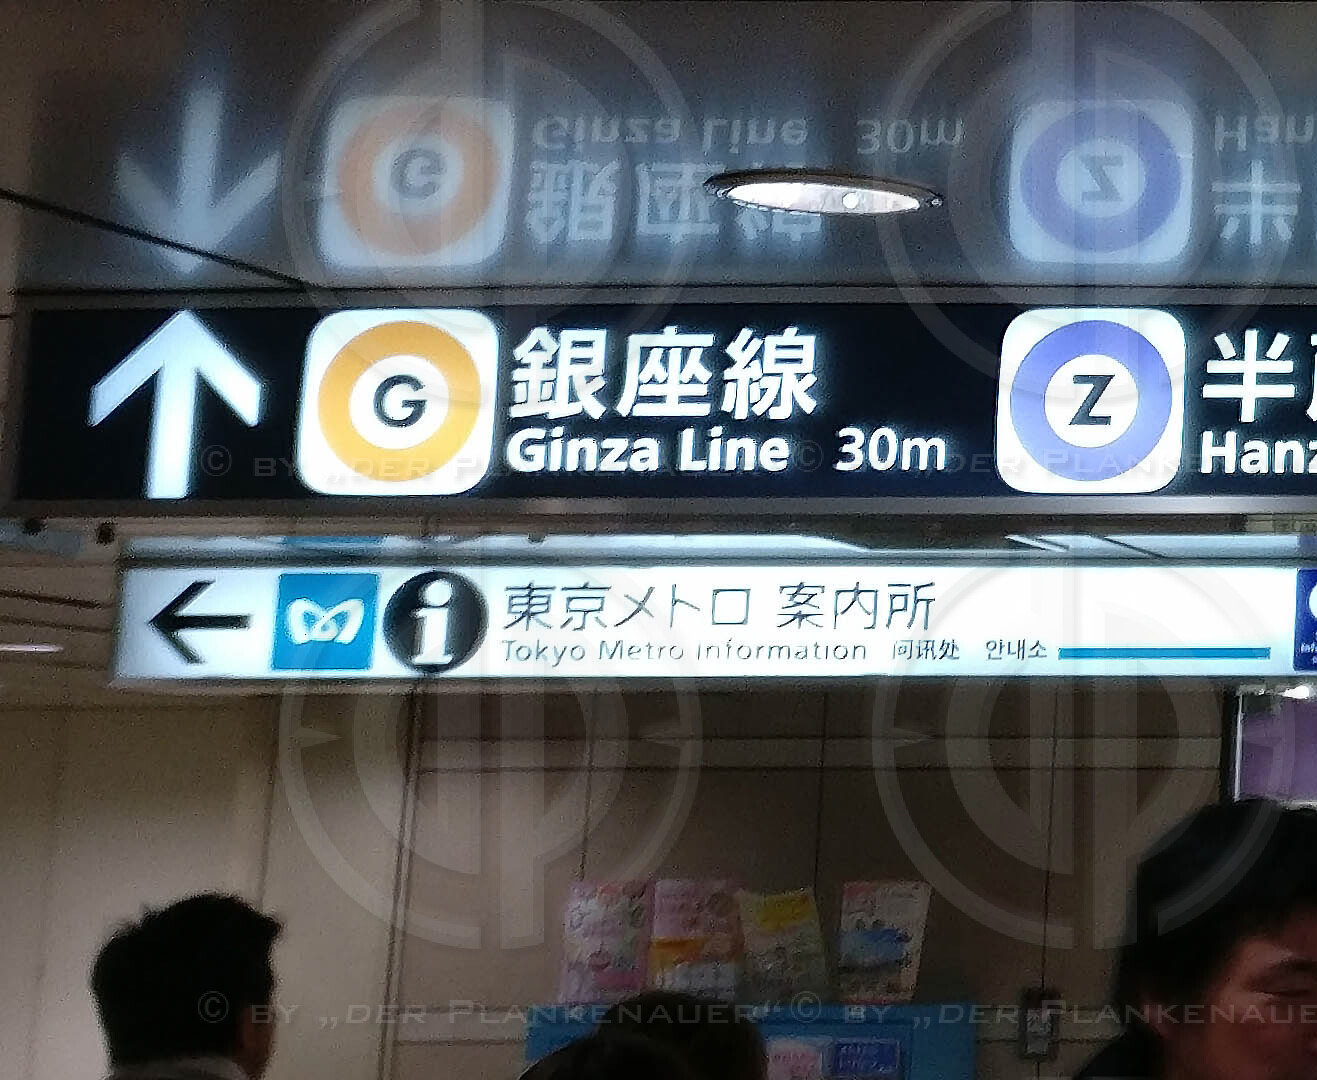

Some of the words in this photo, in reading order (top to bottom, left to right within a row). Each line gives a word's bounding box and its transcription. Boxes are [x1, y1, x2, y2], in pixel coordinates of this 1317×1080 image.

[510, 326, 818, 420] 銀座線
[374, 374, 427, 427] G
[1069, 374, 1116, 425] Z
[507, 426, 659, 473] Ginza
[680, 426, 789, 472] Line
[833, 426, 946, 472] 30m
[504, 581, 751, 632] 東京メトロ
[777, 581, 937, 631] 案内所
[502, 639, 586, 667] Tokyo
[598, 639, 685, 661] Metro
[986, 638, 1048, 662] 안내소
